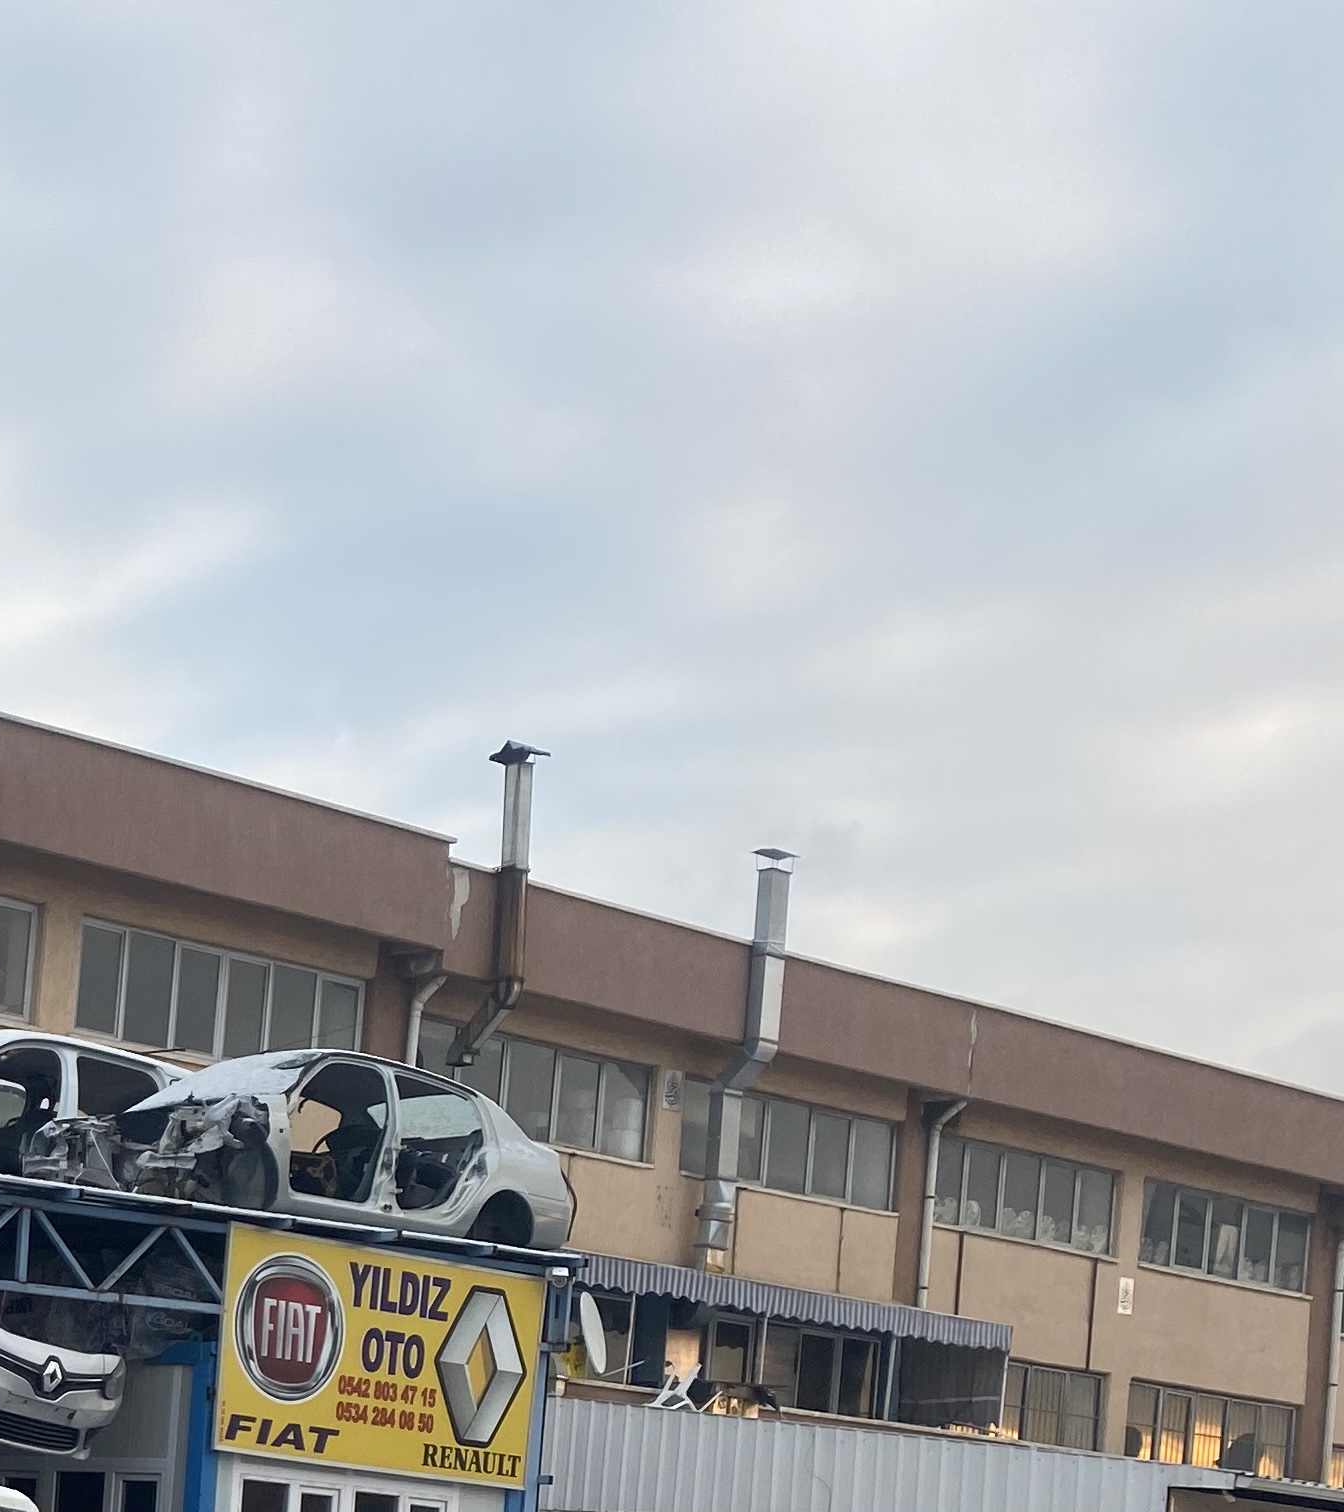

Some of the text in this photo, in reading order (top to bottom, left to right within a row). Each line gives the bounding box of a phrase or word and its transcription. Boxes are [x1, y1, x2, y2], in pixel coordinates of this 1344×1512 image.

[349, 1261, 453, 1322] YILDIZ
[261, 1297, 322, 1364] FIAT
[362, 1327, 425, 1379] OTO
[337, 1374, 437, 1408] 0542 803 47 15
[224, 1413, 340, 1454] FIAT
[335, 1400, 434, 1433] 0534 284 08 50
[421, 1442, 522, 1478] RENAULT
